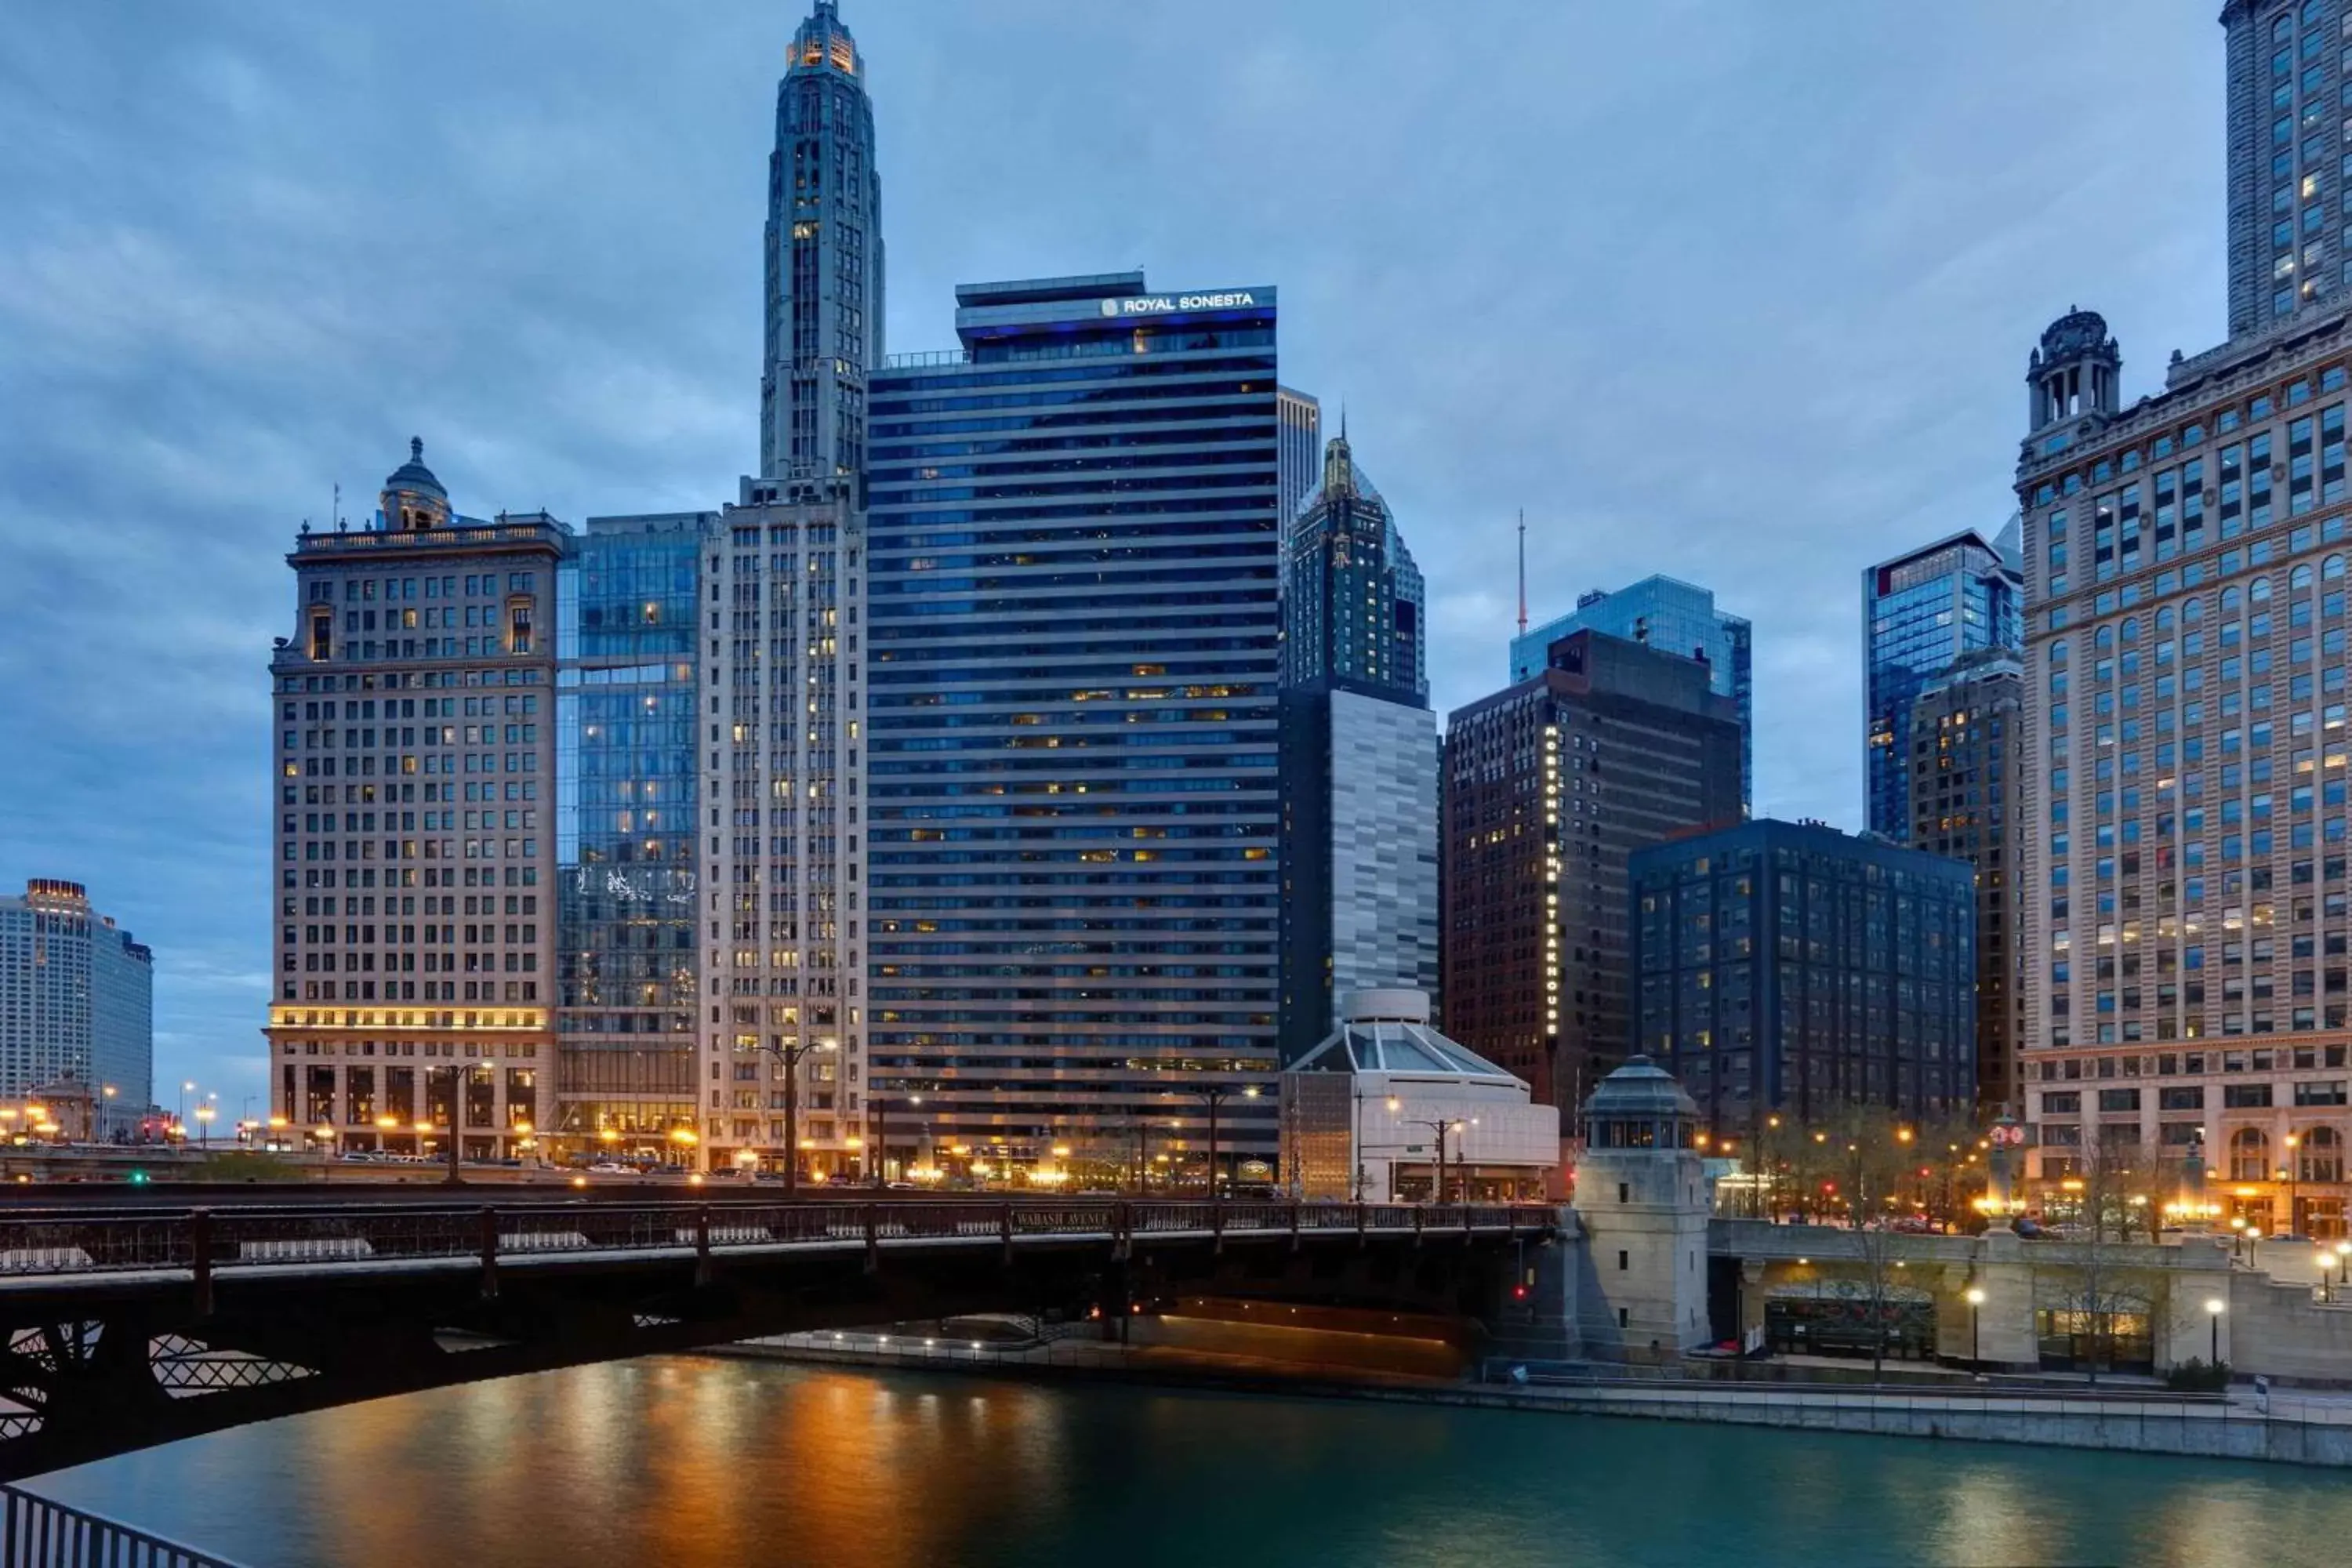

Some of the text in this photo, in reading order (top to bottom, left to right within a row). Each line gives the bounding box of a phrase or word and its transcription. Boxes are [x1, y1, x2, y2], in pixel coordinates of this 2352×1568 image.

[1124, 293, 1254, 313] ROYAL SONESTA
[1547, 843, 1556, 882] THE
[1547, 895, 1557, 1034] STEAKHOUSE
[1017, 1213, 1107, 1225] WABASH AVENUE
